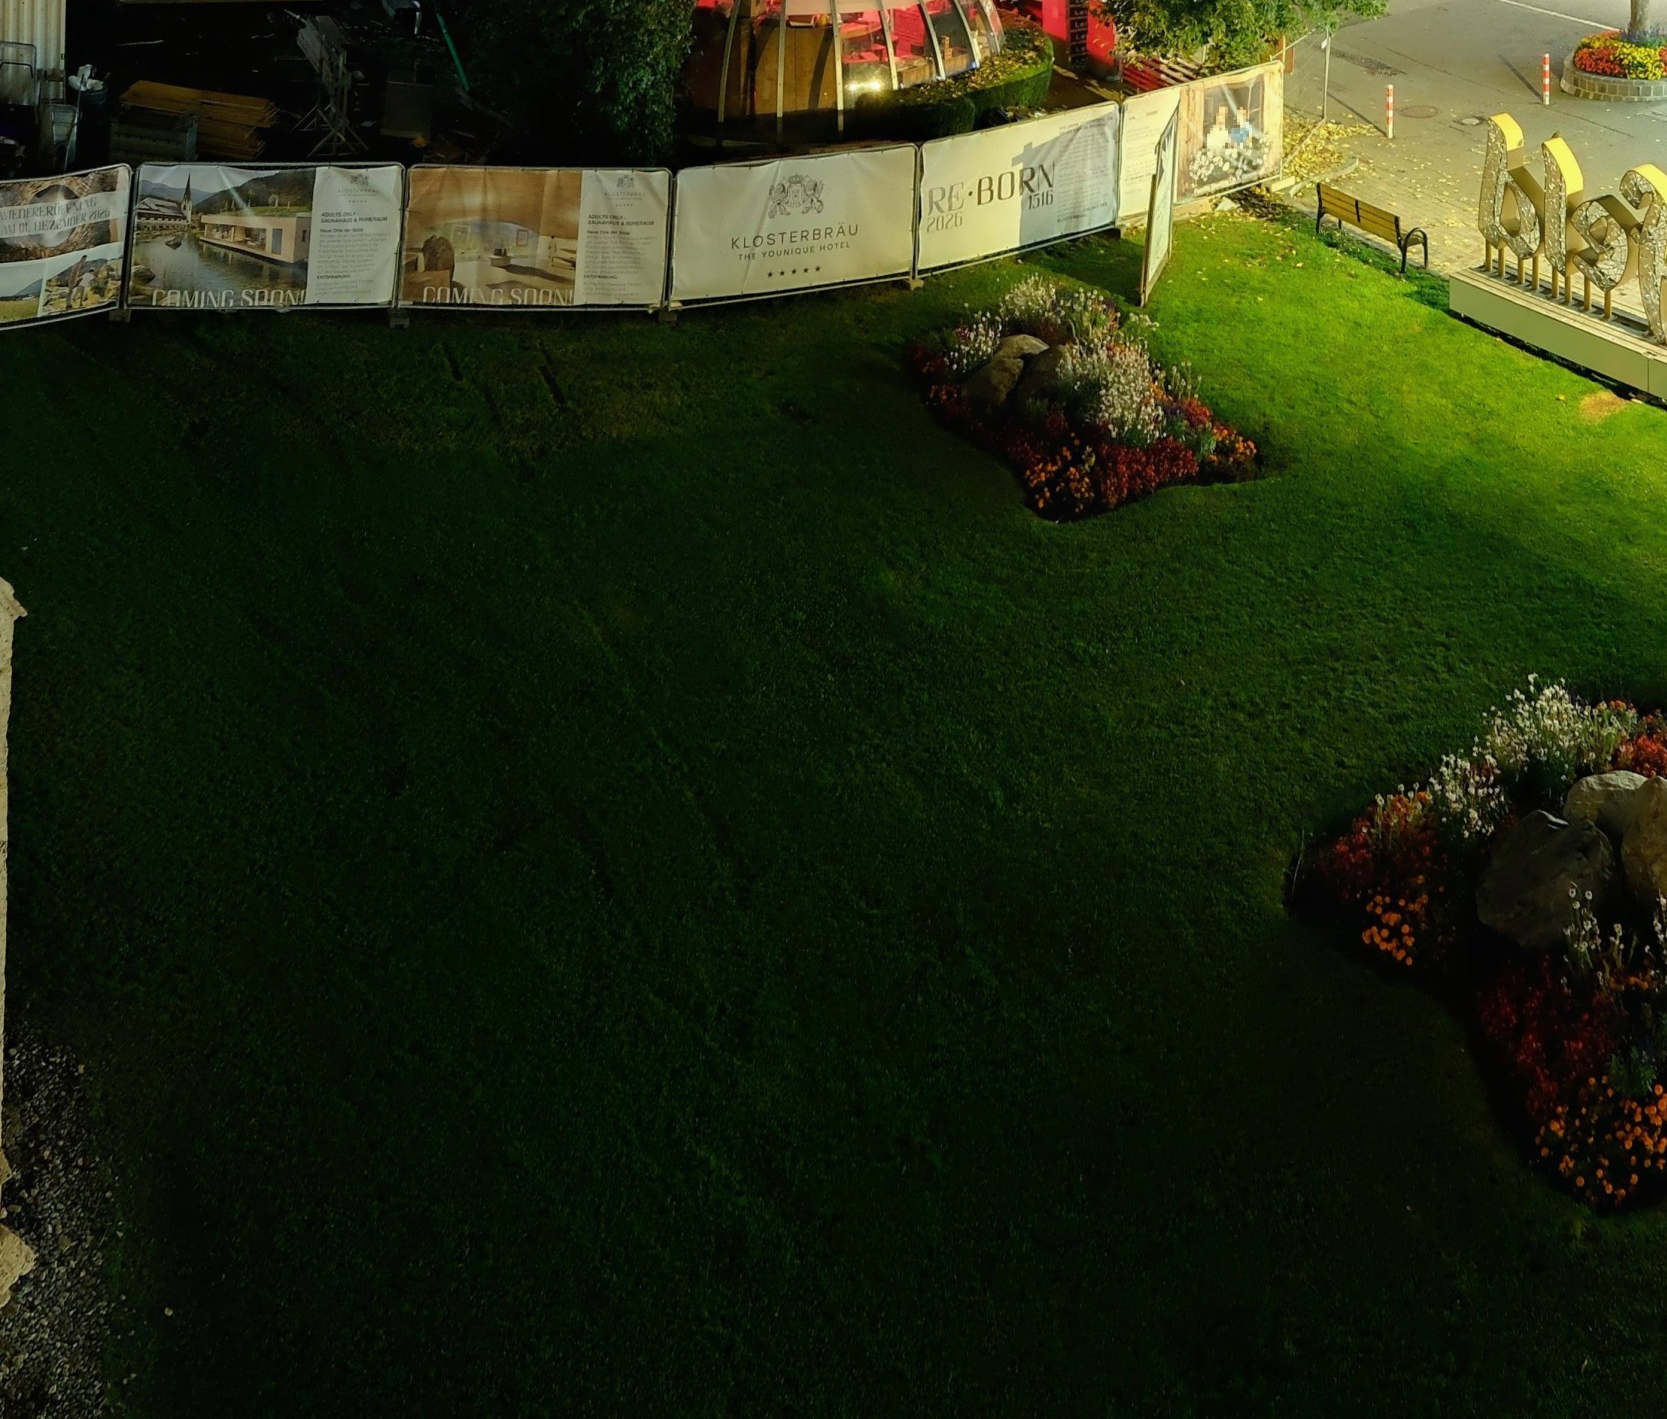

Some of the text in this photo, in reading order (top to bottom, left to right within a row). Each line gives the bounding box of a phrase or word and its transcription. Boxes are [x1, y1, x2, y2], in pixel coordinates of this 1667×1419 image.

[1028, 190, 1055, 211] 1516
[926, 211, 963, 234] 2026
[731, 222, 860, 249] KLOSTERBRÄU
[738, 241, 850, 261] THE YOUNIQUE HOTEL
[152, 289, 306, 307] COMING SOON!
